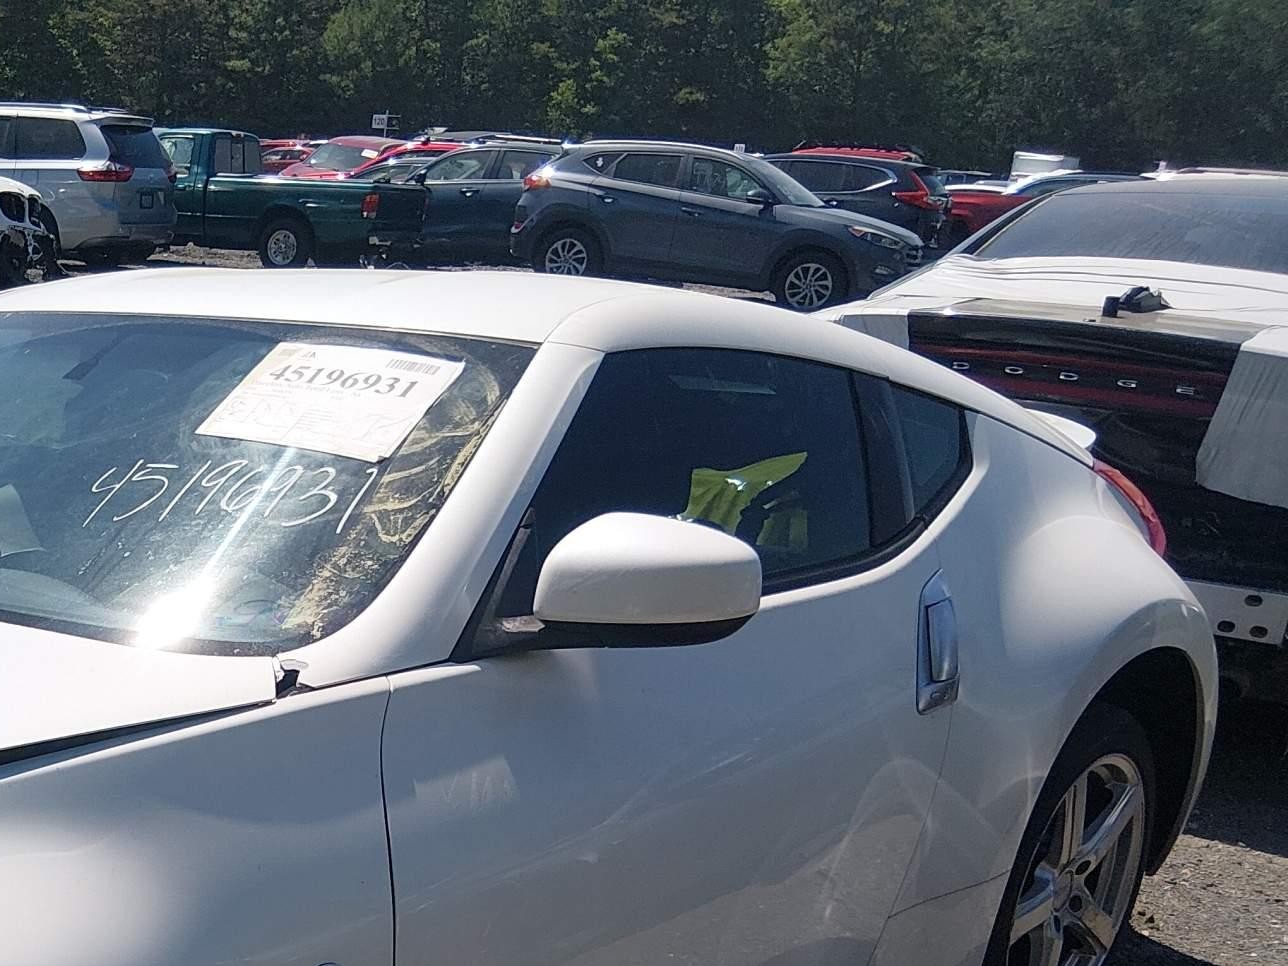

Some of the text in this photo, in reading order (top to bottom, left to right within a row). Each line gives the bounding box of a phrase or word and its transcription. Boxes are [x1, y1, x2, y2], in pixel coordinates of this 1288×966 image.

[269, 364, 419, 398] 45196931
[952, 361, 1197, 396] DODGE
[82, 459, 378, 535] 45196931
